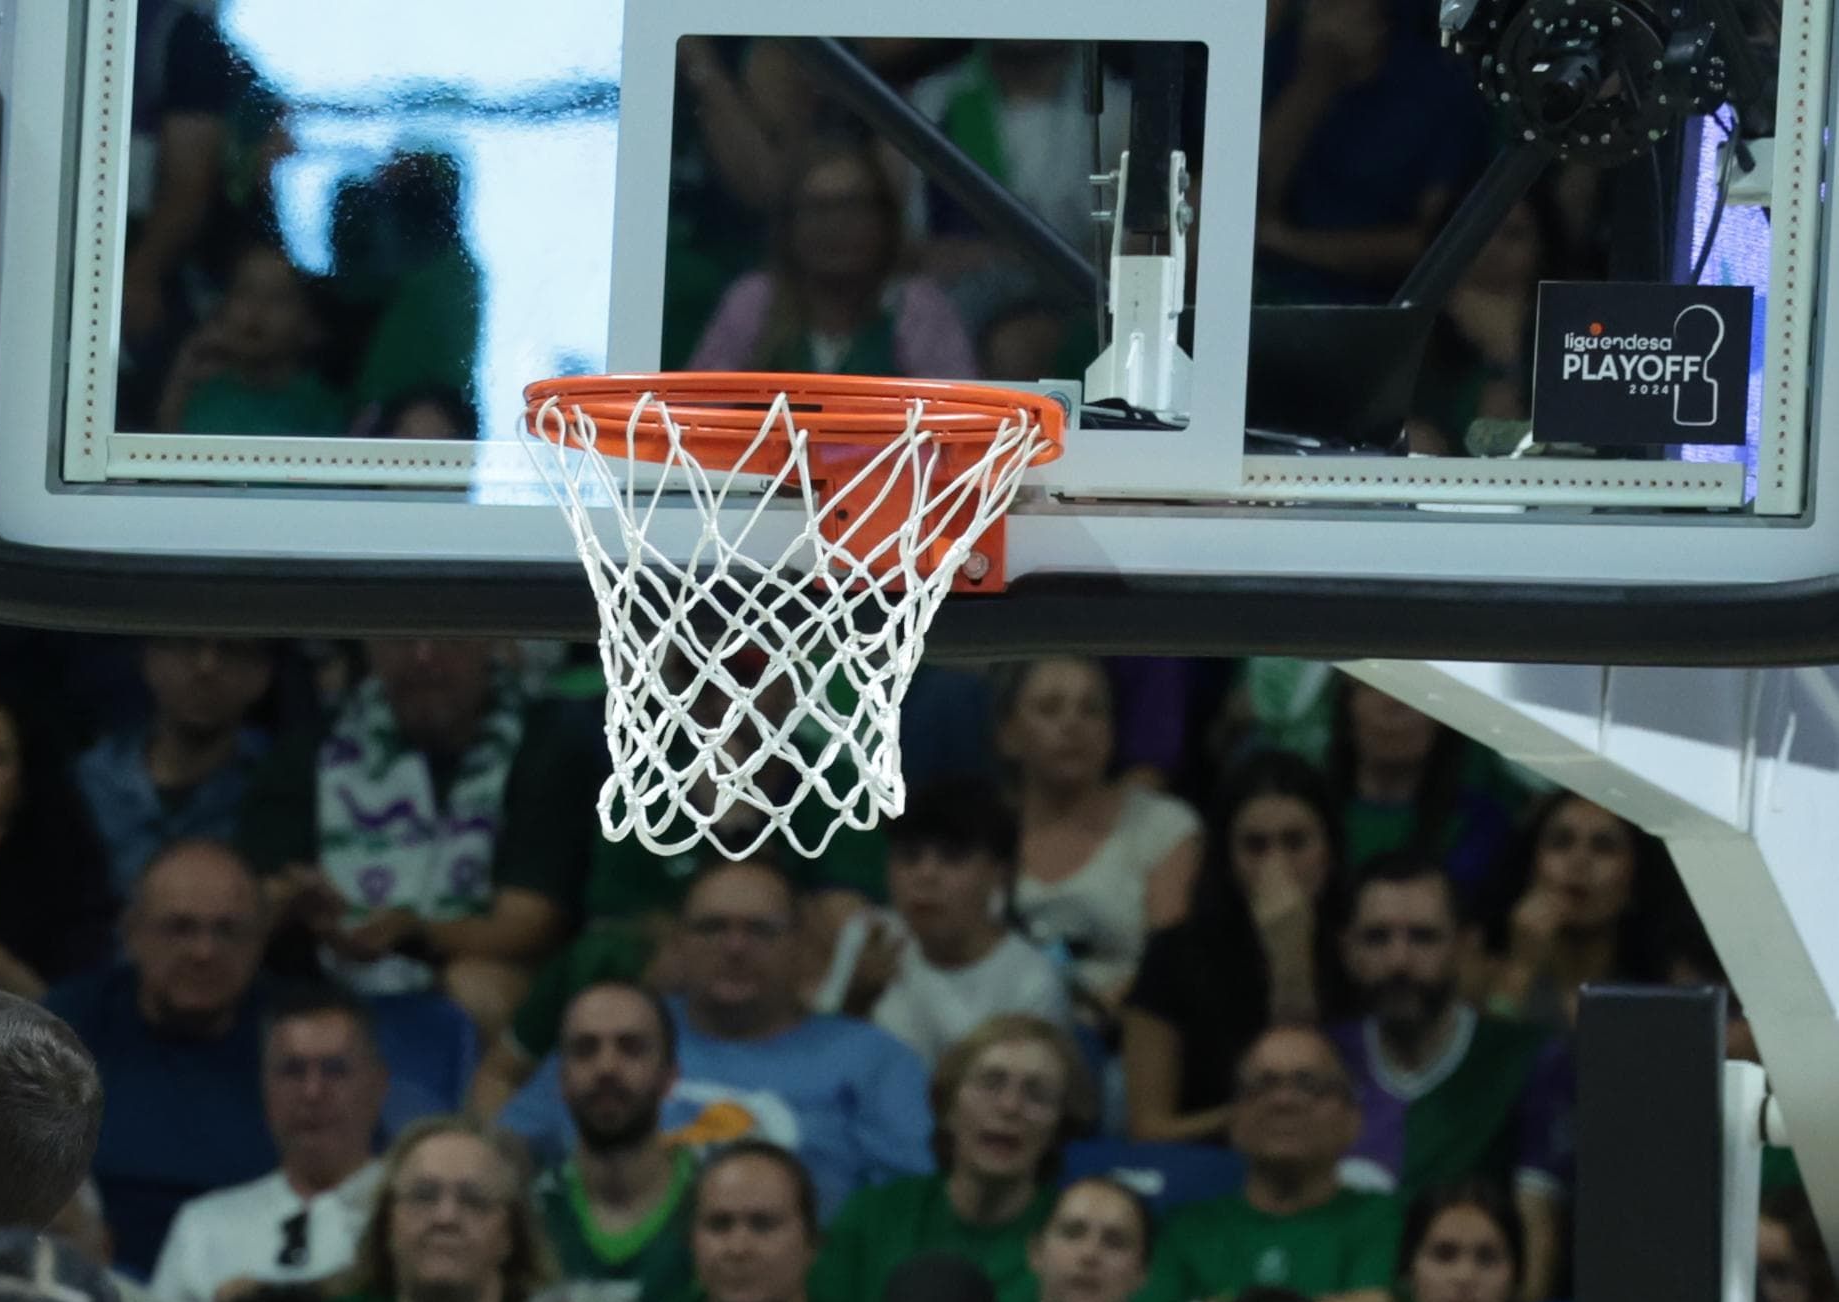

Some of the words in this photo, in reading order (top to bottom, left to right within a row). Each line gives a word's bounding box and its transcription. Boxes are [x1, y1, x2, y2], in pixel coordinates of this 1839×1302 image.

[1564, 332, 1599, 352] liga
[1600, 334, 1672, 351] endesa
[1562, 353, 1702, 382] PLAYOFF
[1628, 384, 1669, 395] 2024
